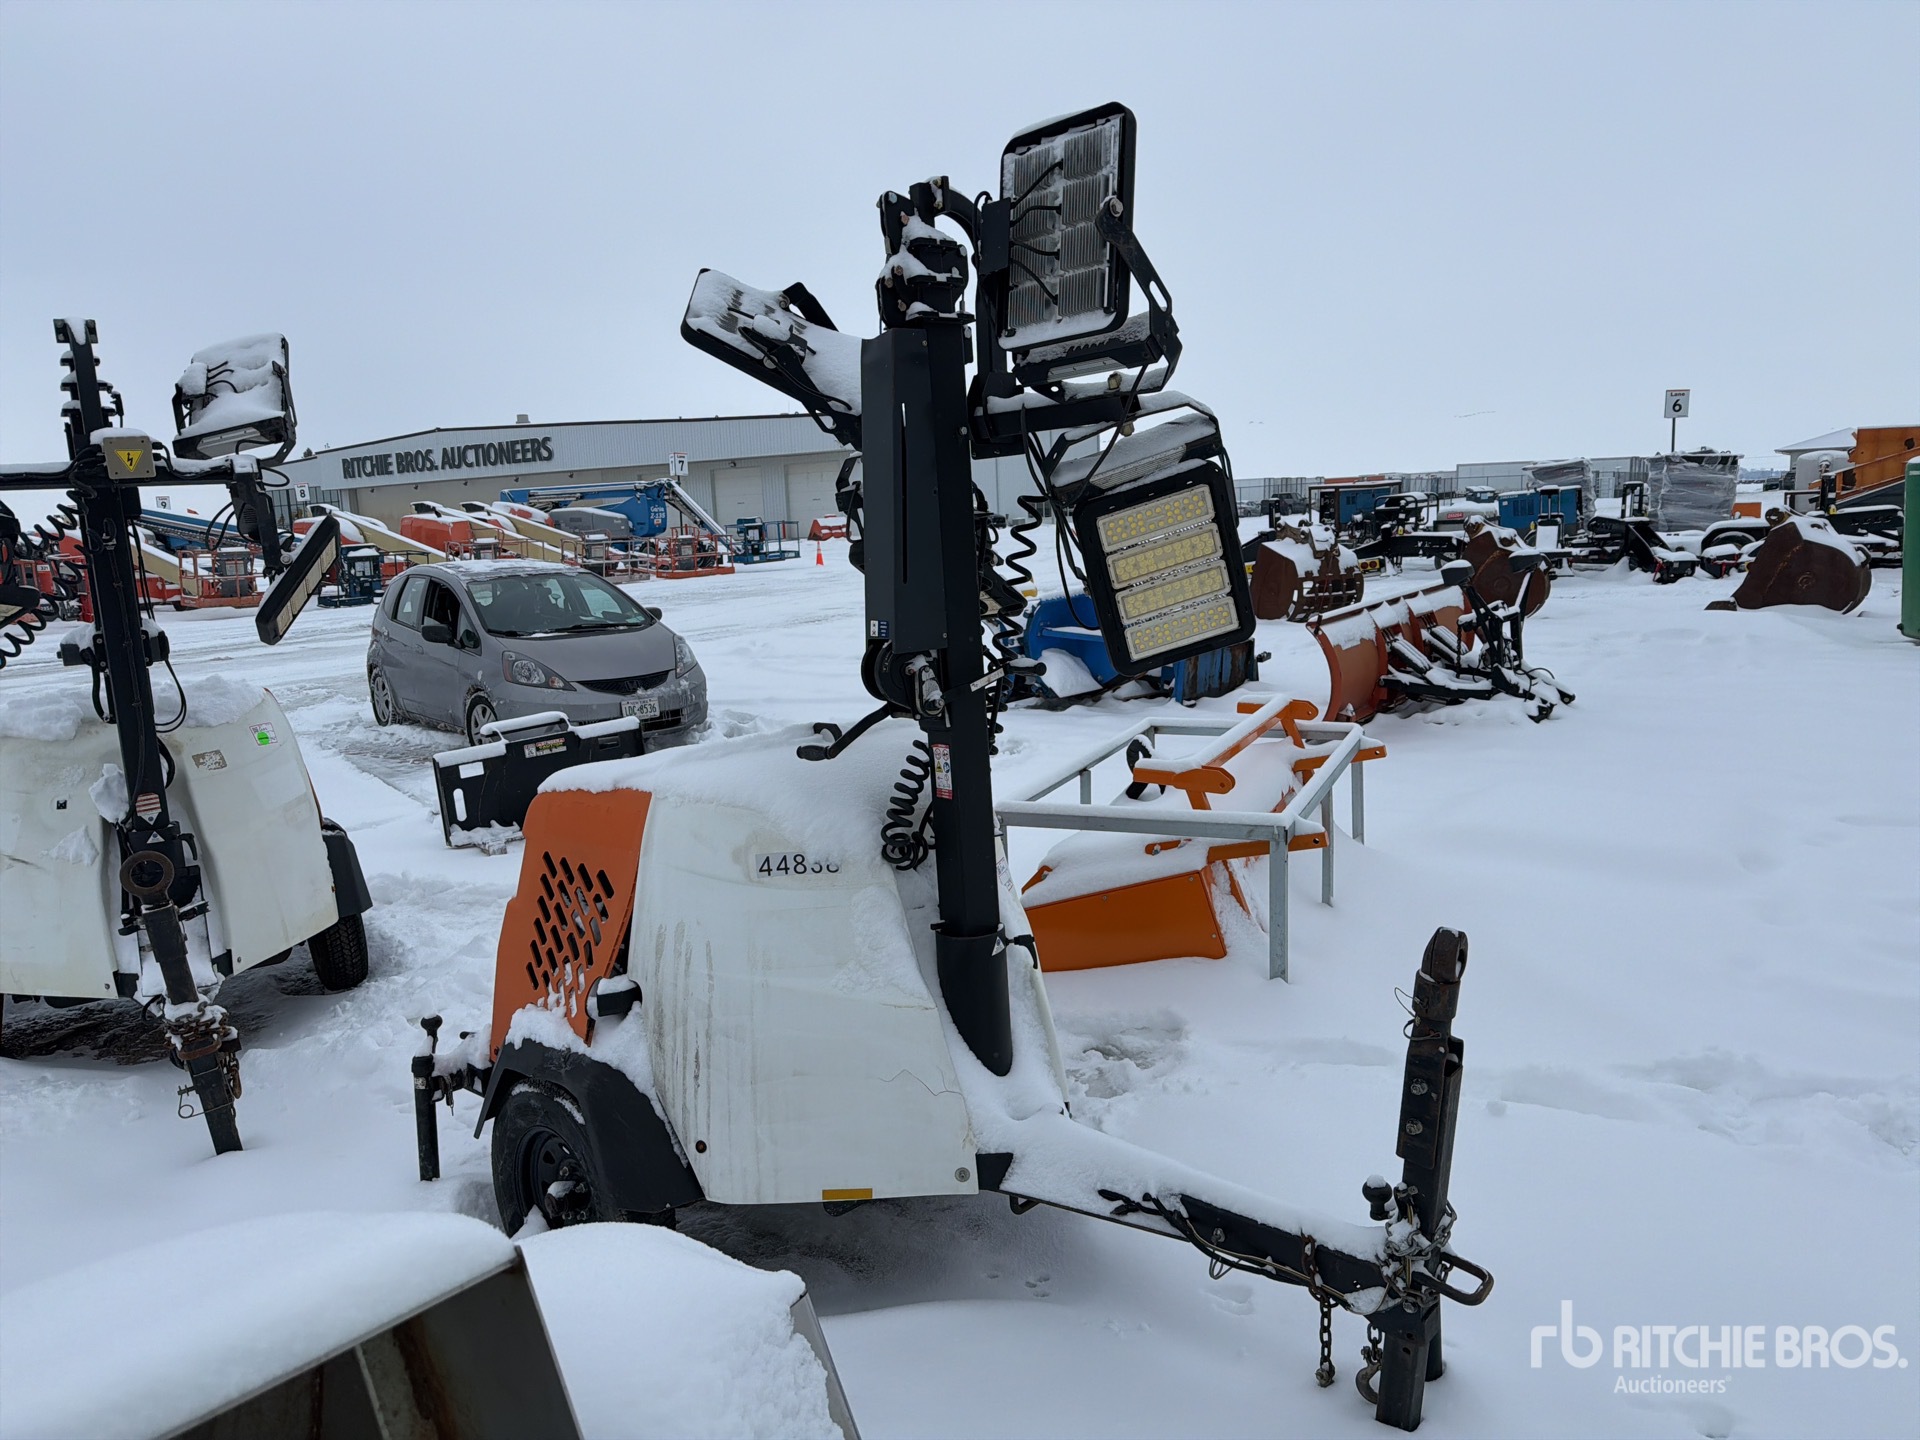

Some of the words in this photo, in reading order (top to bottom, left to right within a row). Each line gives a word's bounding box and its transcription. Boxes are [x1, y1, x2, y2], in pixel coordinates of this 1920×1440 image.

[1672, 398, 1682, 413] 6
[341, 453, 393, 479] RITCHIE
[395, 449, 439, 474] BROS.
[441, 436, 554, 470] AUCTIONEERS
[678, 459, 685, 471] 7
[300, 489, 306, 498] 8
[161, 501, 167, 509] 9
[624, 705, 637, 716] LDC
[639, 703, 657, 714] 8536
